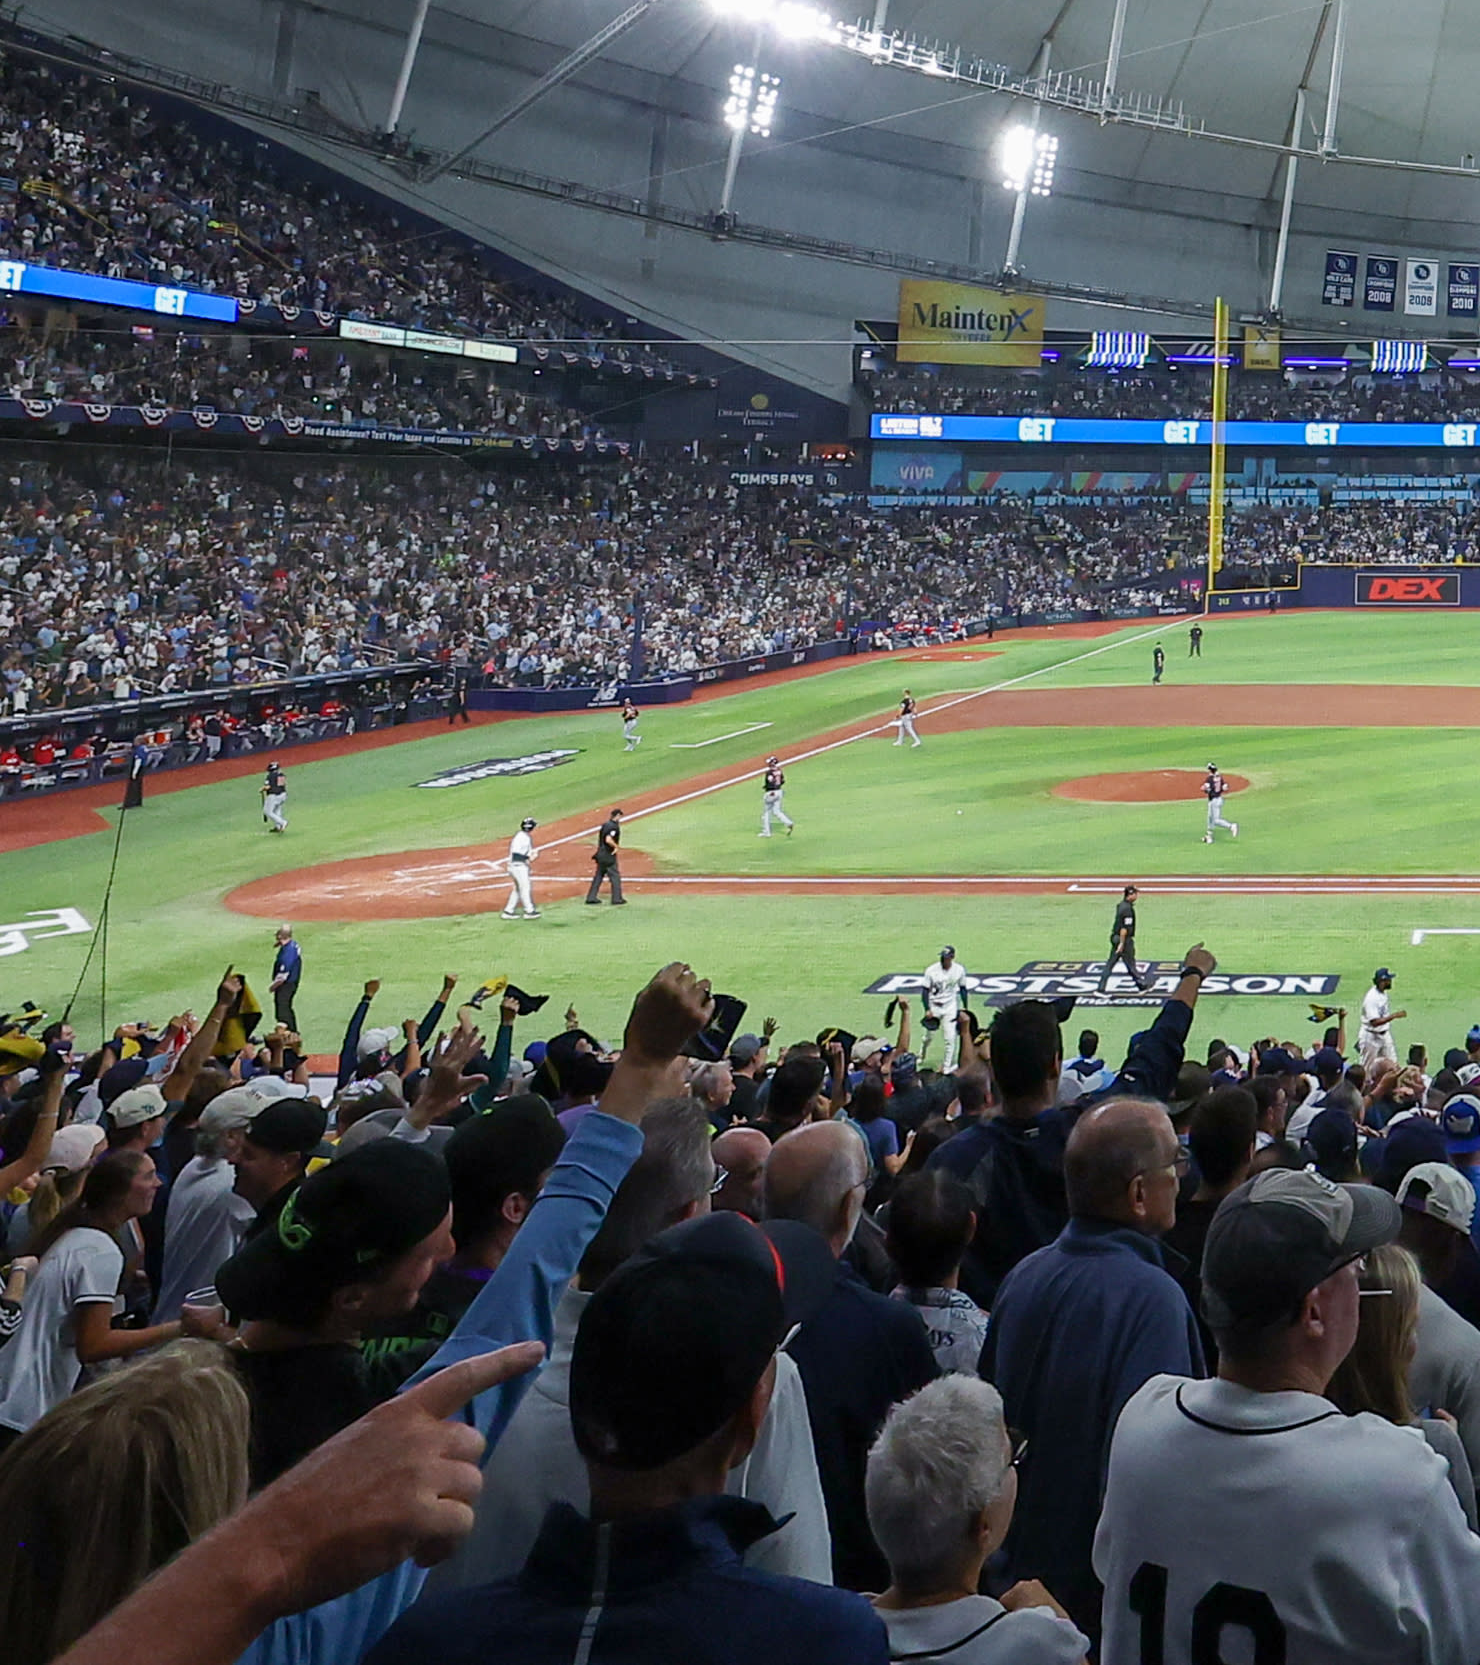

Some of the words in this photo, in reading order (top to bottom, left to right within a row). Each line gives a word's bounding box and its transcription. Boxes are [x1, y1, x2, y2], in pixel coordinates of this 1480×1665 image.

[154, 286, 188, 316] GET
[1452, 298, 1474, 310] 2010
[912, 303, 1034, 342] MaintenX
[1019, 418, 1056, 442] GET
[1163, 421, 1200, 444] GET
[1305, 423, 1340, 445] GET
[1443, 424, 1477, 447] GET
[900, 466, 934, 480] VIVA
[1368, 577, 1446, 600] DEX
[877, 974, 1331, 994] PSTSEASON
